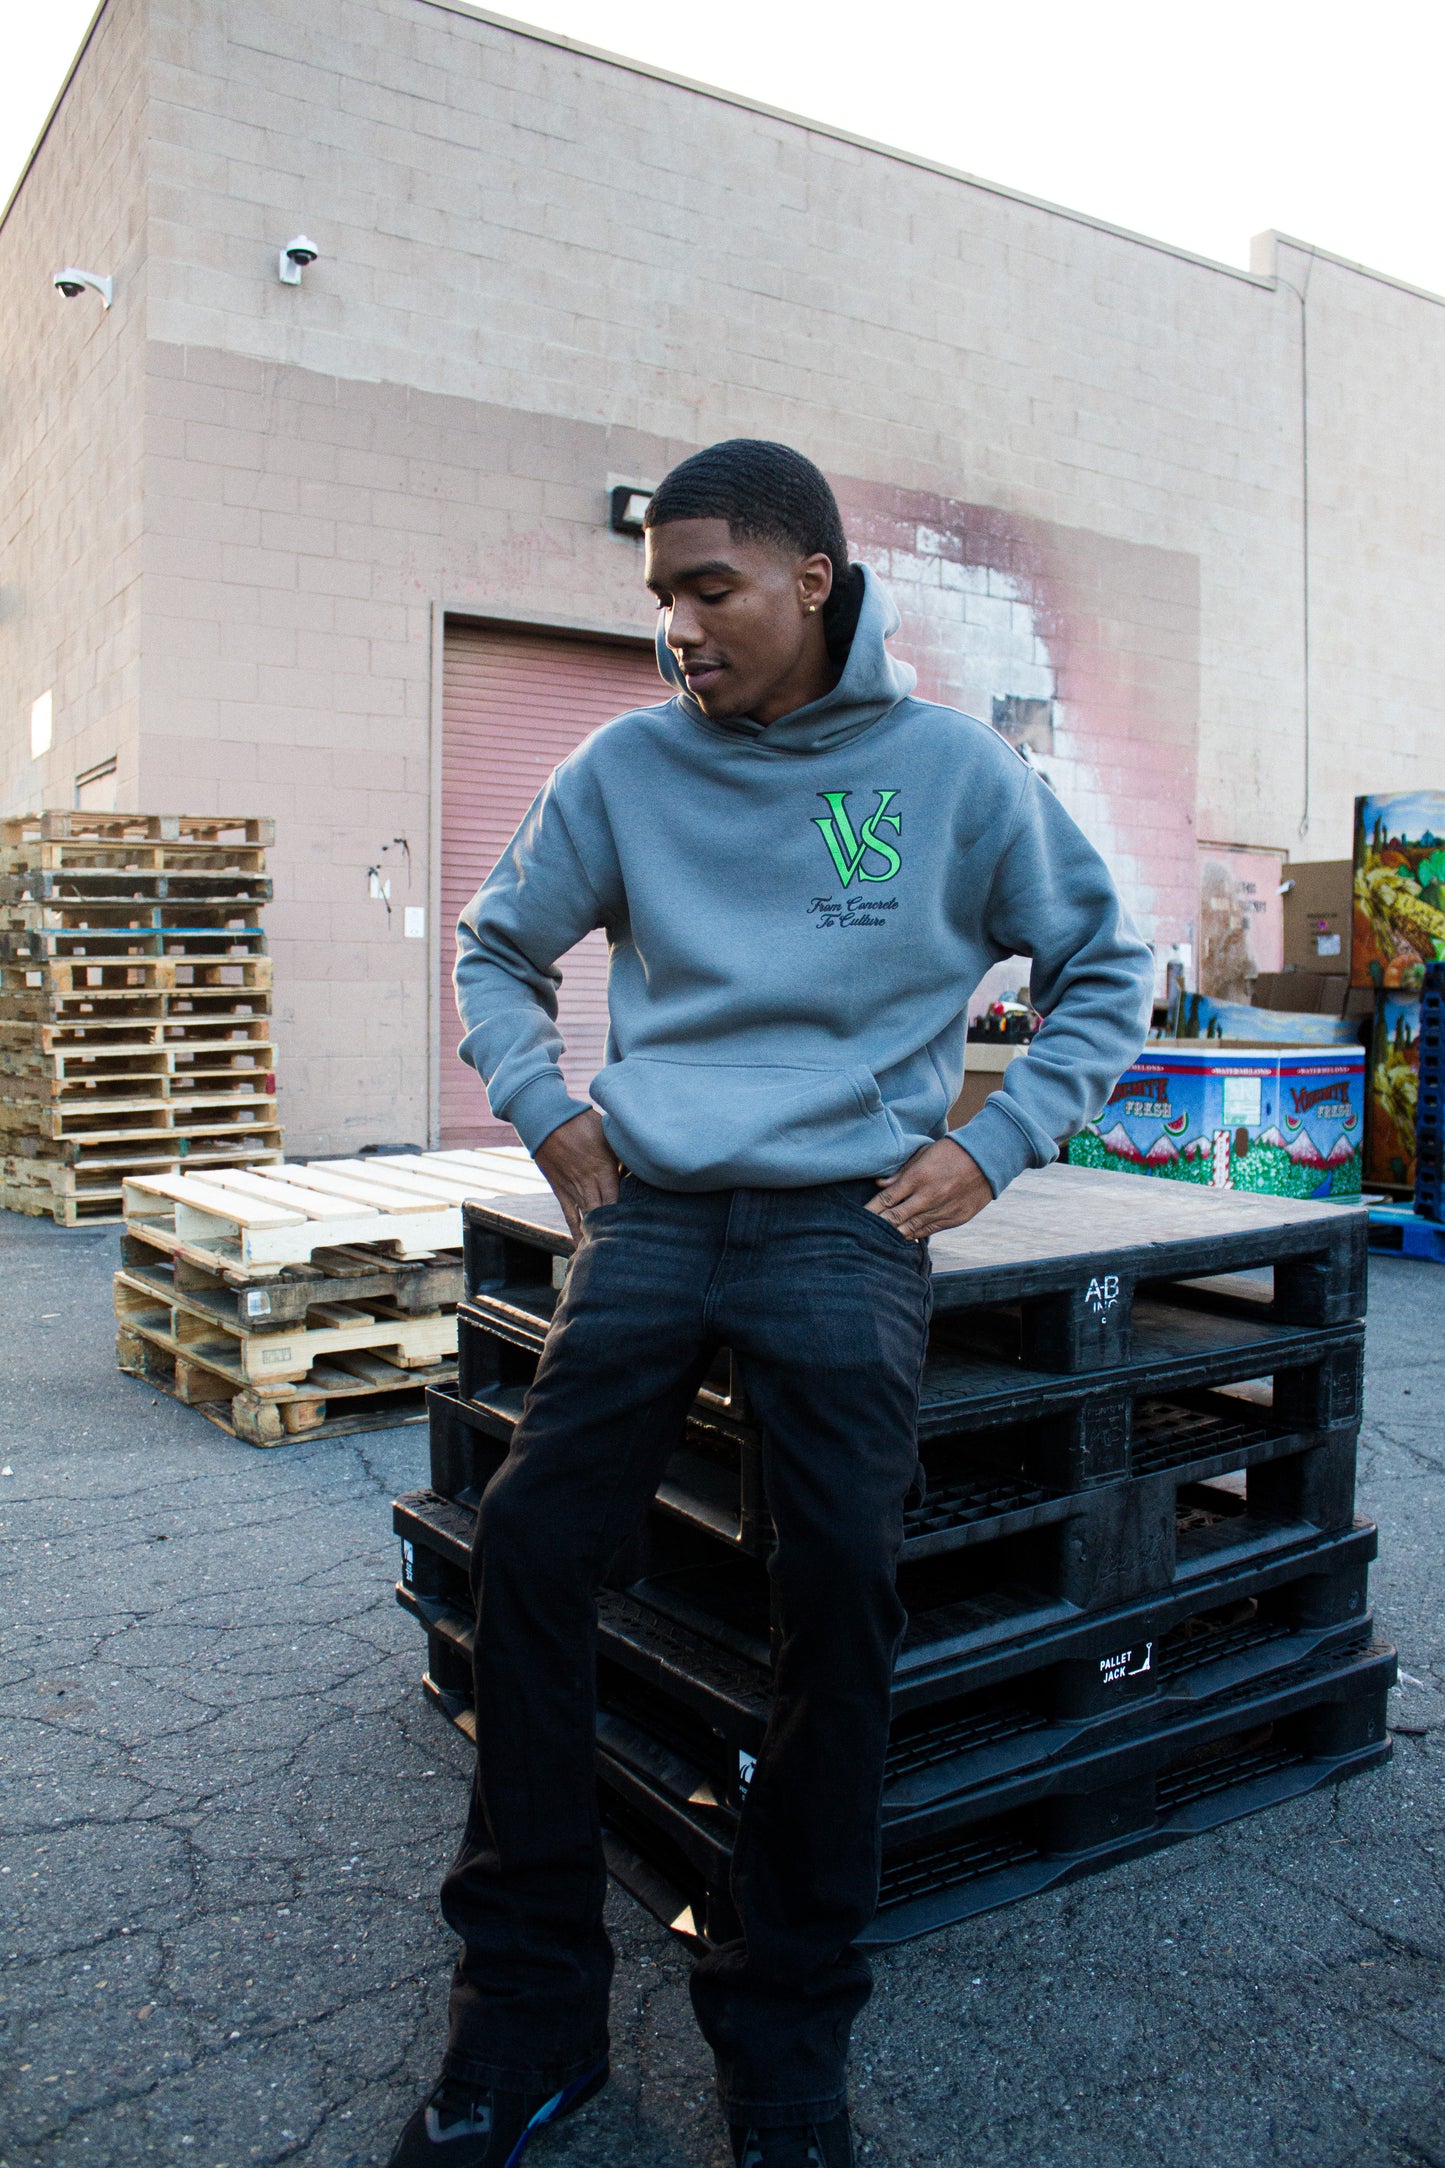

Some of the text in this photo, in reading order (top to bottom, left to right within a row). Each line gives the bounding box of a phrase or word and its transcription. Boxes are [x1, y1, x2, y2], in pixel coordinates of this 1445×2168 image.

[806, 895, 900, 914] From Concrete
[816, 911, 886, 929] To Culture
[1290, 1081, 1350, 1113] YOSEMITE
[1125, 1099, 1172, 1119] FRESH
[1317, 1104, 1352, 1119] FRESH
[1100, 1651, 1132, 1671] PALLET
[1103, 1666, 1126, 1684] JACK
